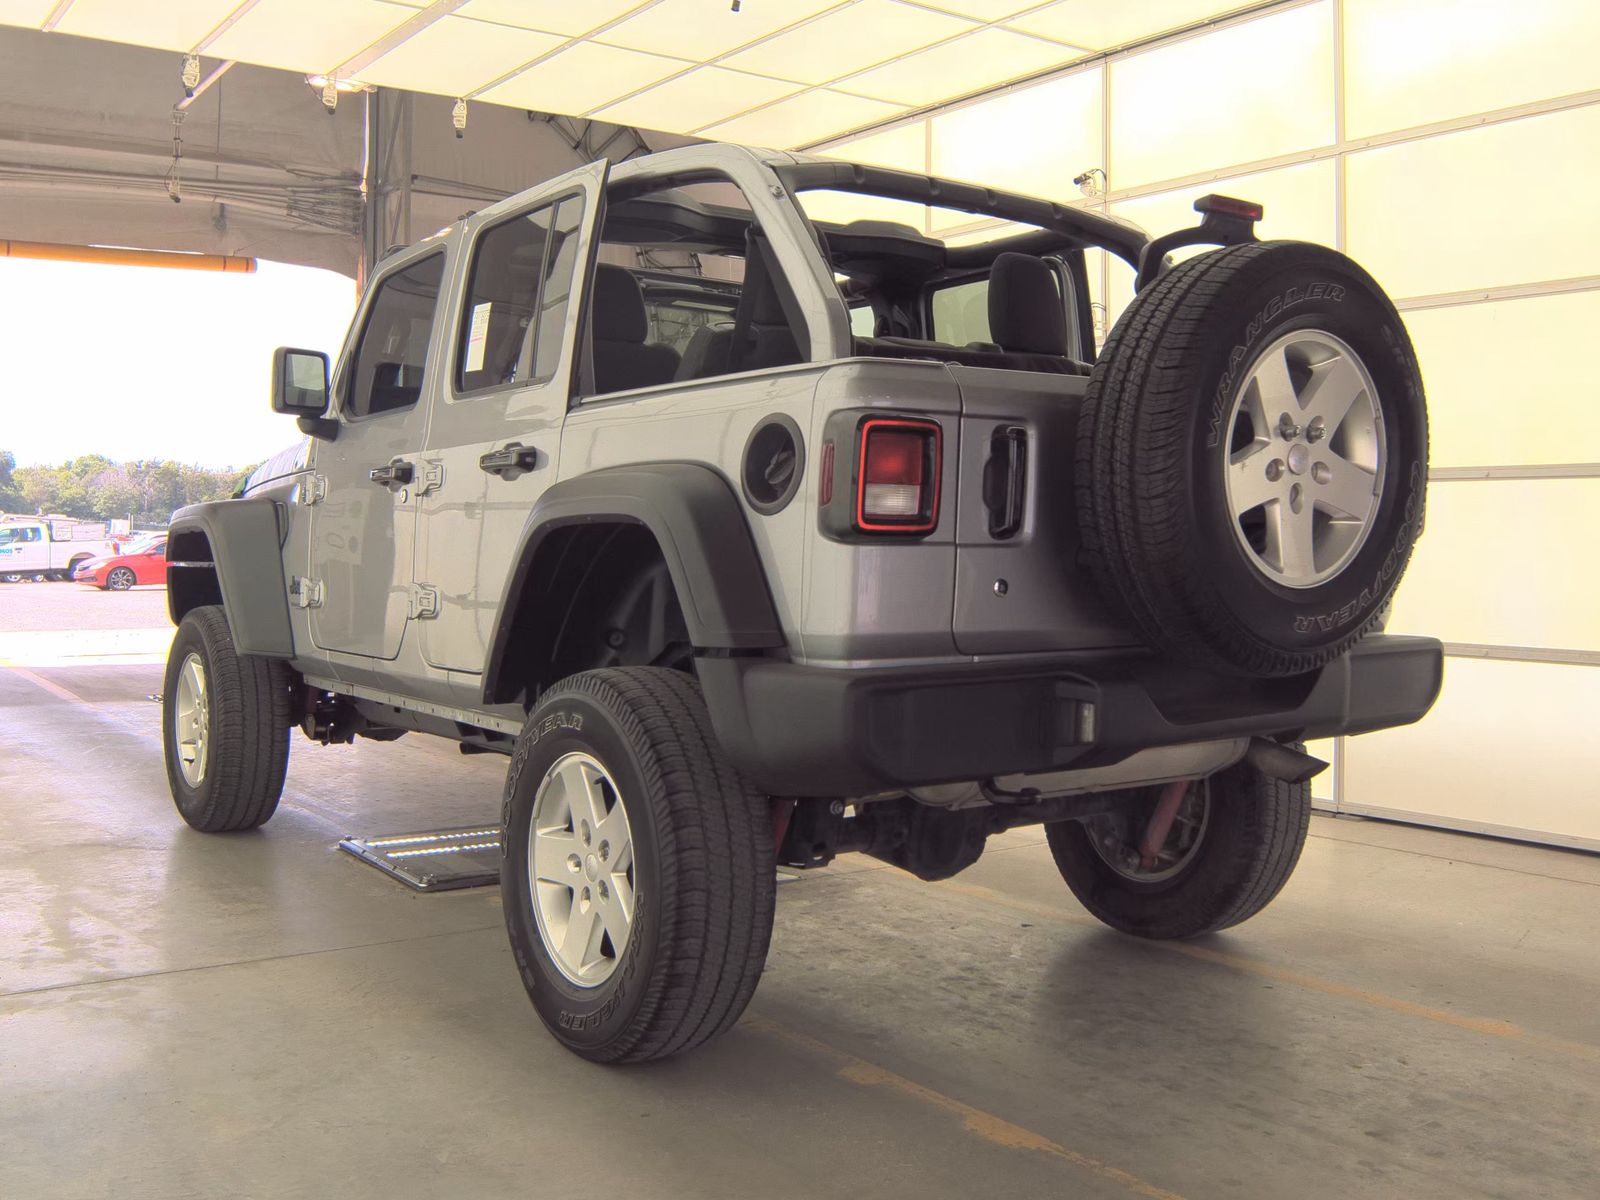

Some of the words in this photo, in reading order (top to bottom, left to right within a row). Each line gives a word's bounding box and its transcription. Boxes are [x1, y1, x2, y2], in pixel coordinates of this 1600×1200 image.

[1208, 283, 1346, 447] WRANGLER
[1294, 460, 1423, 632] GOODYEAR
[502, 712, 583, 858] GOODYEAR
